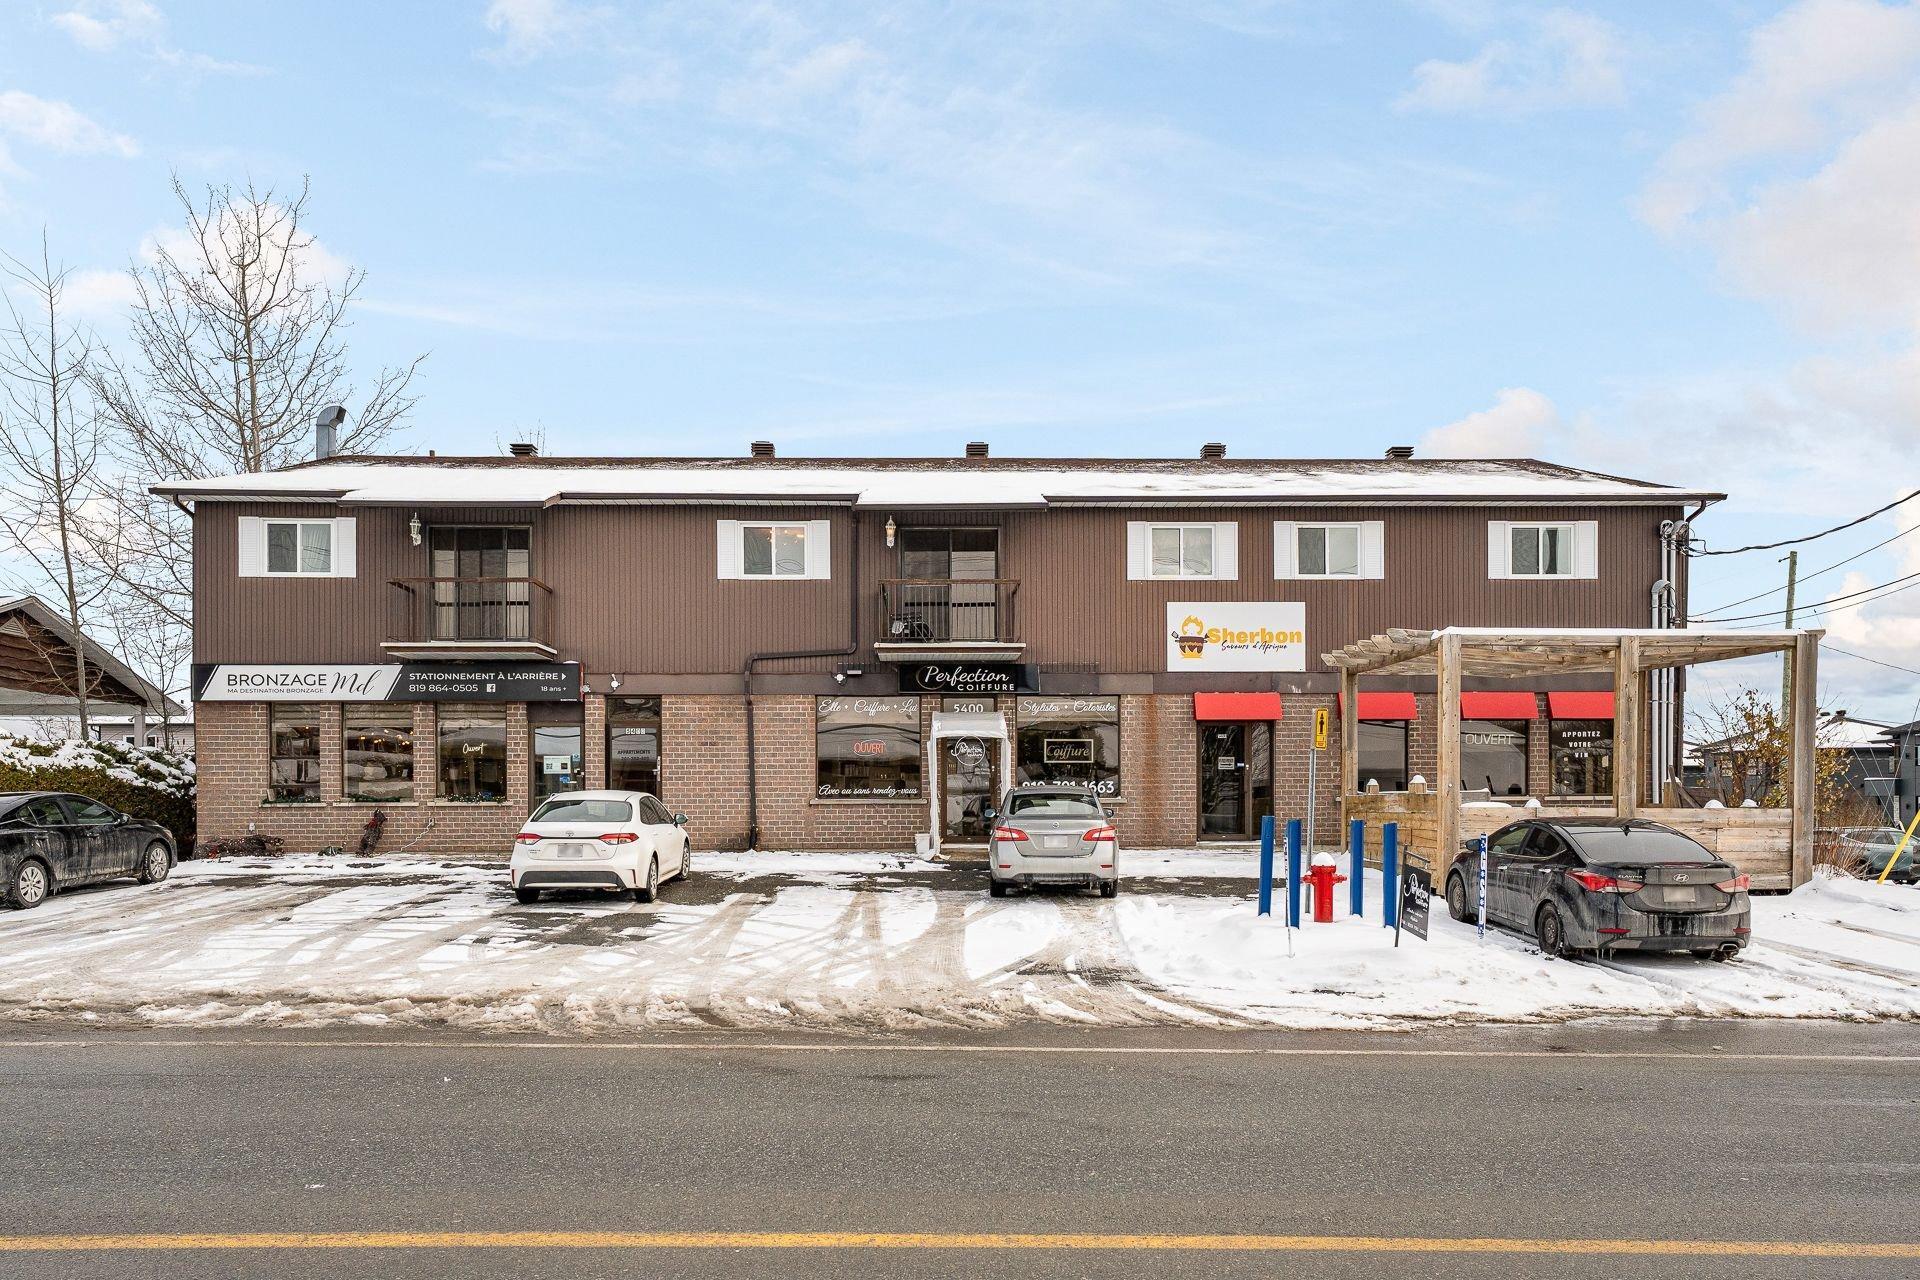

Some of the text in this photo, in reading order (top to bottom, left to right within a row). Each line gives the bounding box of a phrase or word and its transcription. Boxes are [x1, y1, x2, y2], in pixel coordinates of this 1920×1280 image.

[1207, 627, 1302, 643] Sherbon
[1221, 639, 1249, 651] Saveurs
[227, 673, 327, 686] BRONZAGE
[409, 671, 559, 680] STATIONNEMENT À L'ARRIÈRE
[925, 665, 1010, 686] Perfection
[408, 684, 426, 692] 819
[428, 684, 479, 692] 864-0505
[957, 683, 1015, 691] COIFFURE
[818, 699, 842, 713] Elle
[854, 699, 891, 717] Coiffure
[953, 703, 984, 713] 5400
[1018, 699, 1117, 716] Stylistes Coloristes
[1465, 733, 1514, 745] OUVERT
[1562, 730, 1601, 738] APPORTEZ
[462, 742, 488, 755] Ouvert
[853, 741, 885, 753] OUVERT
[1046, 743, 1090, 759] Coiffure
[818, 784, 839, 795] Avec
[853, 787, 870, 795] sans
[871, 785, 918, 797] rendez-vous
